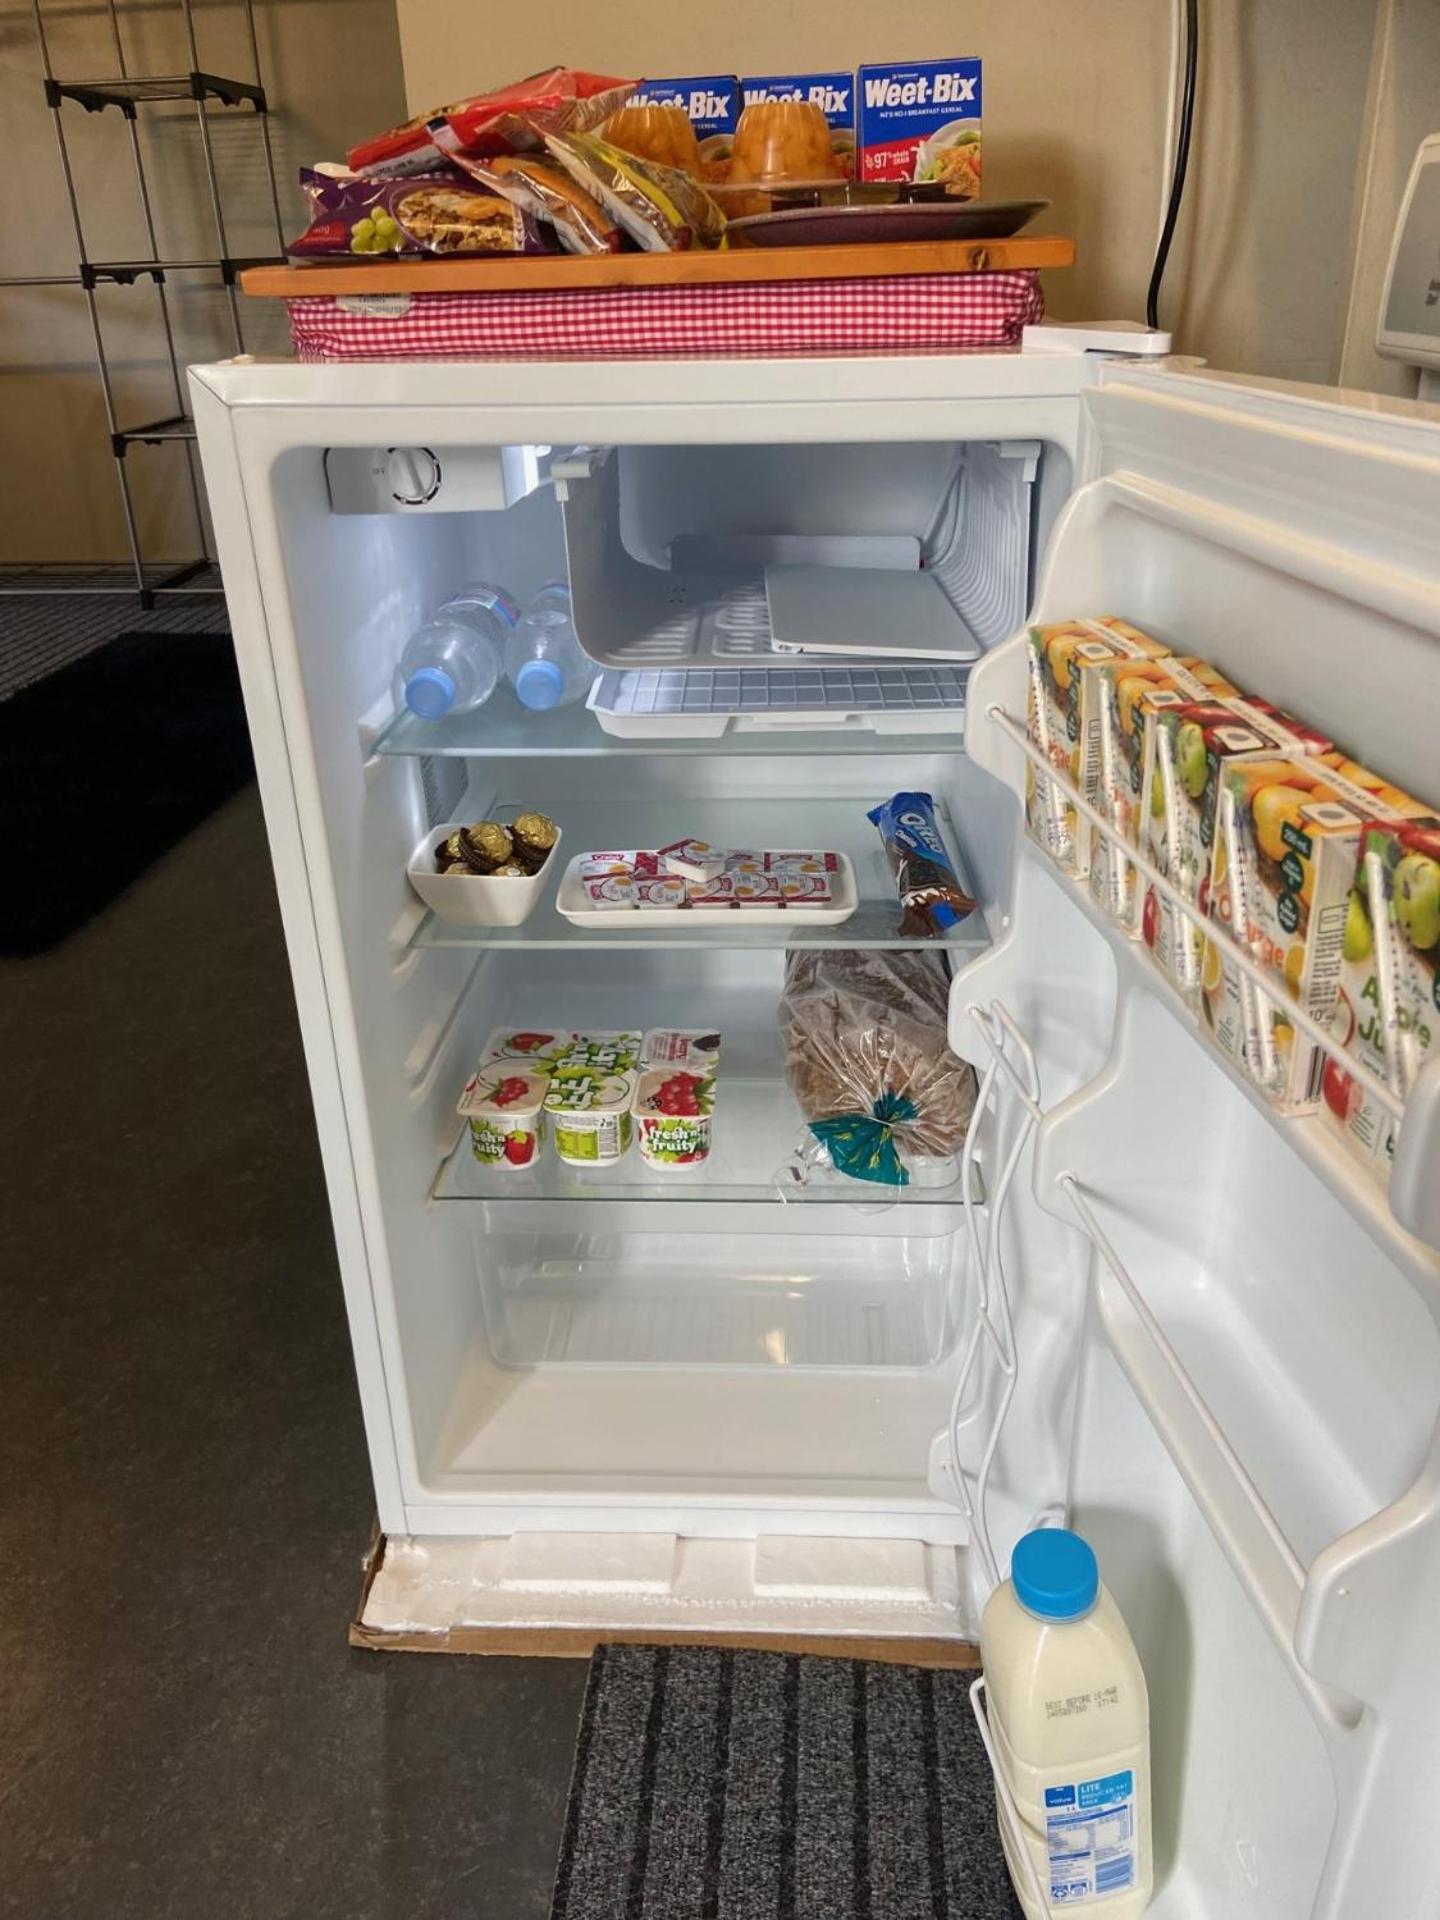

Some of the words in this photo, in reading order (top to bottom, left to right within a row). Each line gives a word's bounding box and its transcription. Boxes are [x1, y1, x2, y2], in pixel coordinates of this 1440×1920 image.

[865, 73, 977, 108] Weet-Bix
[908, 107, 939, 116] BREAKFAST
[941, 106, 963, 114] CEREAL
[653, 1138, 696, 1154] fruity
[1081, 1783, 1100, 1793] LITE
